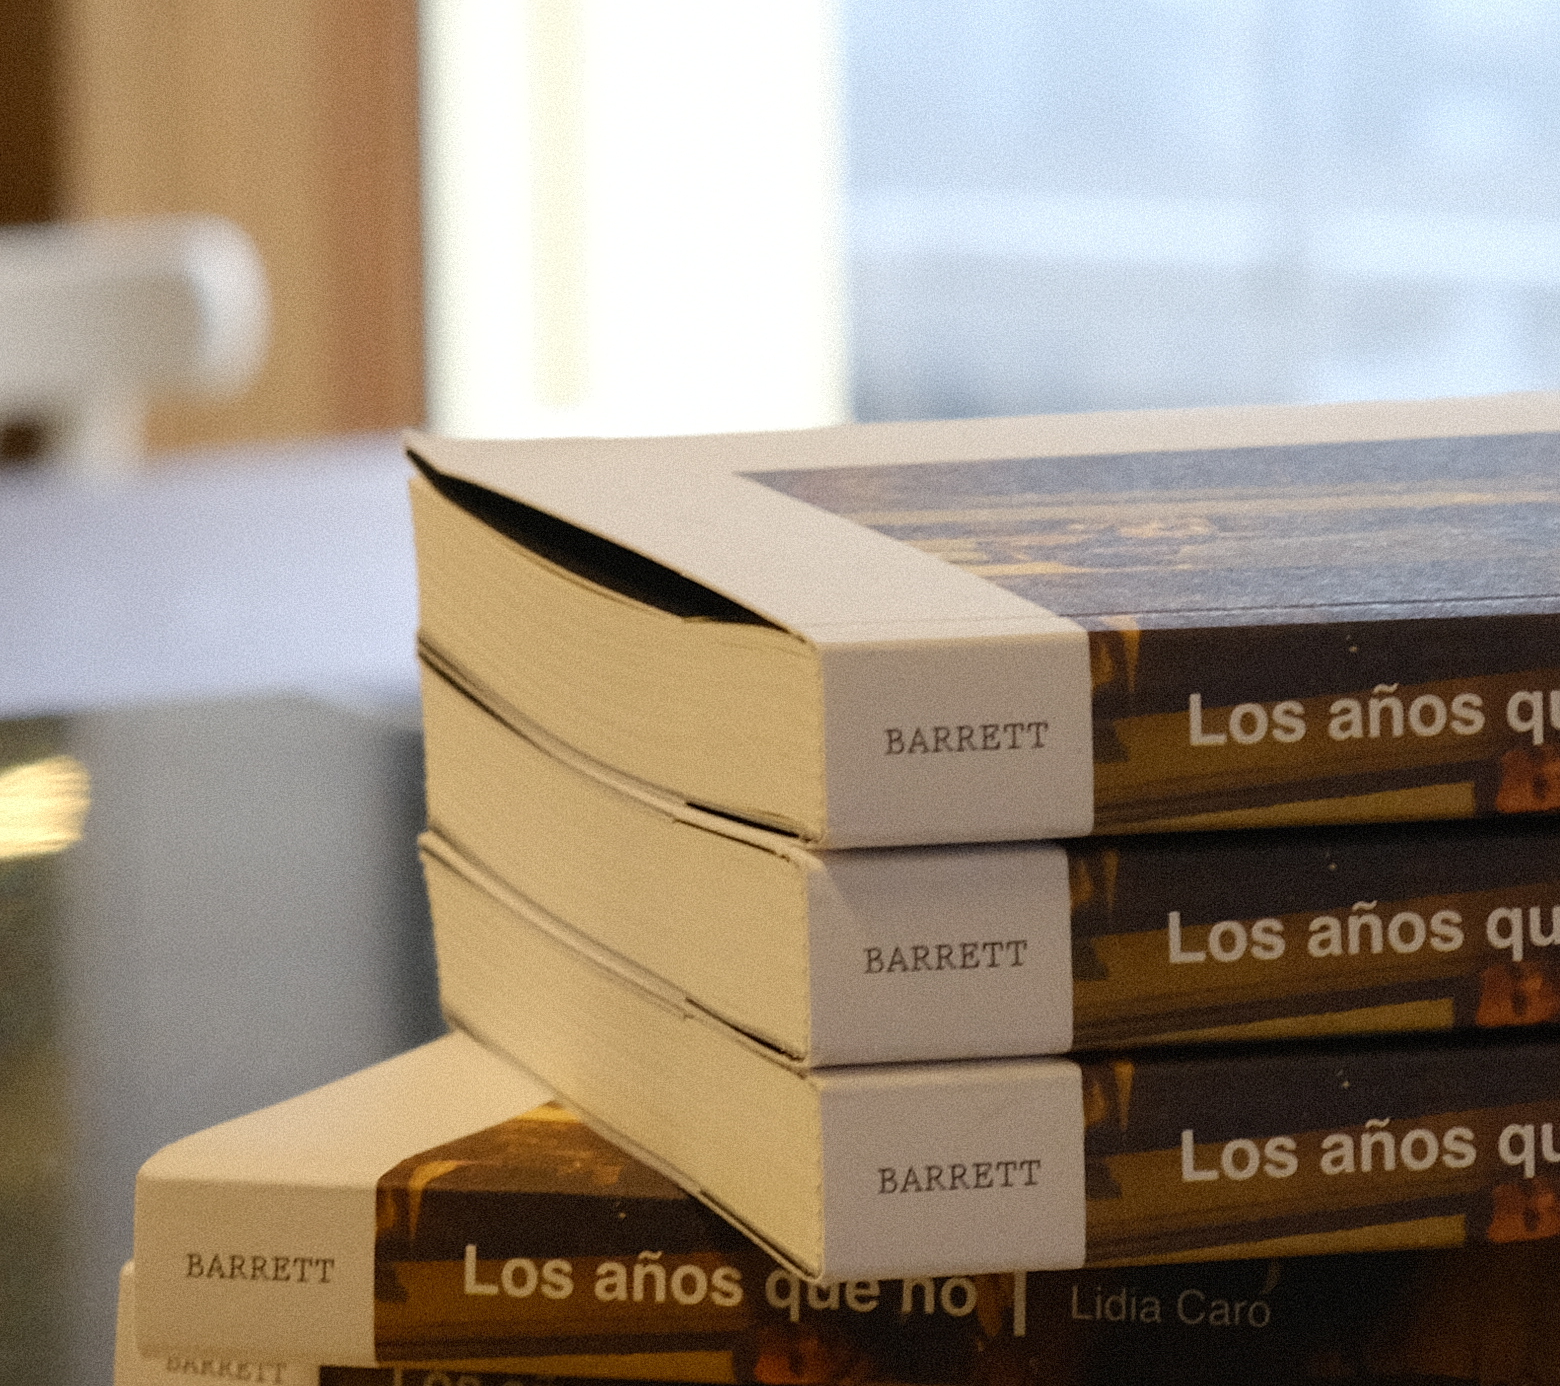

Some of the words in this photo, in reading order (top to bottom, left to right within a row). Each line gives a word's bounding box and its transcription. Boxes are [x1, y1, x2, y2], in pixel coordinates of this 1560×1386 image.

[885, 720, 1050, 756] BARRETT
[1189, 694, 1306, 747] Los
[1328, 685, 1485, 741] años
[1168, 911, 1286, 964] Los
[1307, 902, 1464, 958] años
[865, 939, 1028, 974] BARRETT
[1181, 1130, 1298, 1182] Los
[1320, 1119, 1476, 1175] años
[878, 1158, 1042, 1195] BARRETT
[186, 1252, 335, 1284] BARRETT
[464, 1244, 574, 1299] Los
[594, 1251, 742, 1307] años
[899, 1273, 979, 1316] no
[1070, 1284, 1161, 1323] Lidia
[1176, 1287, 1272, 1328] Caro
